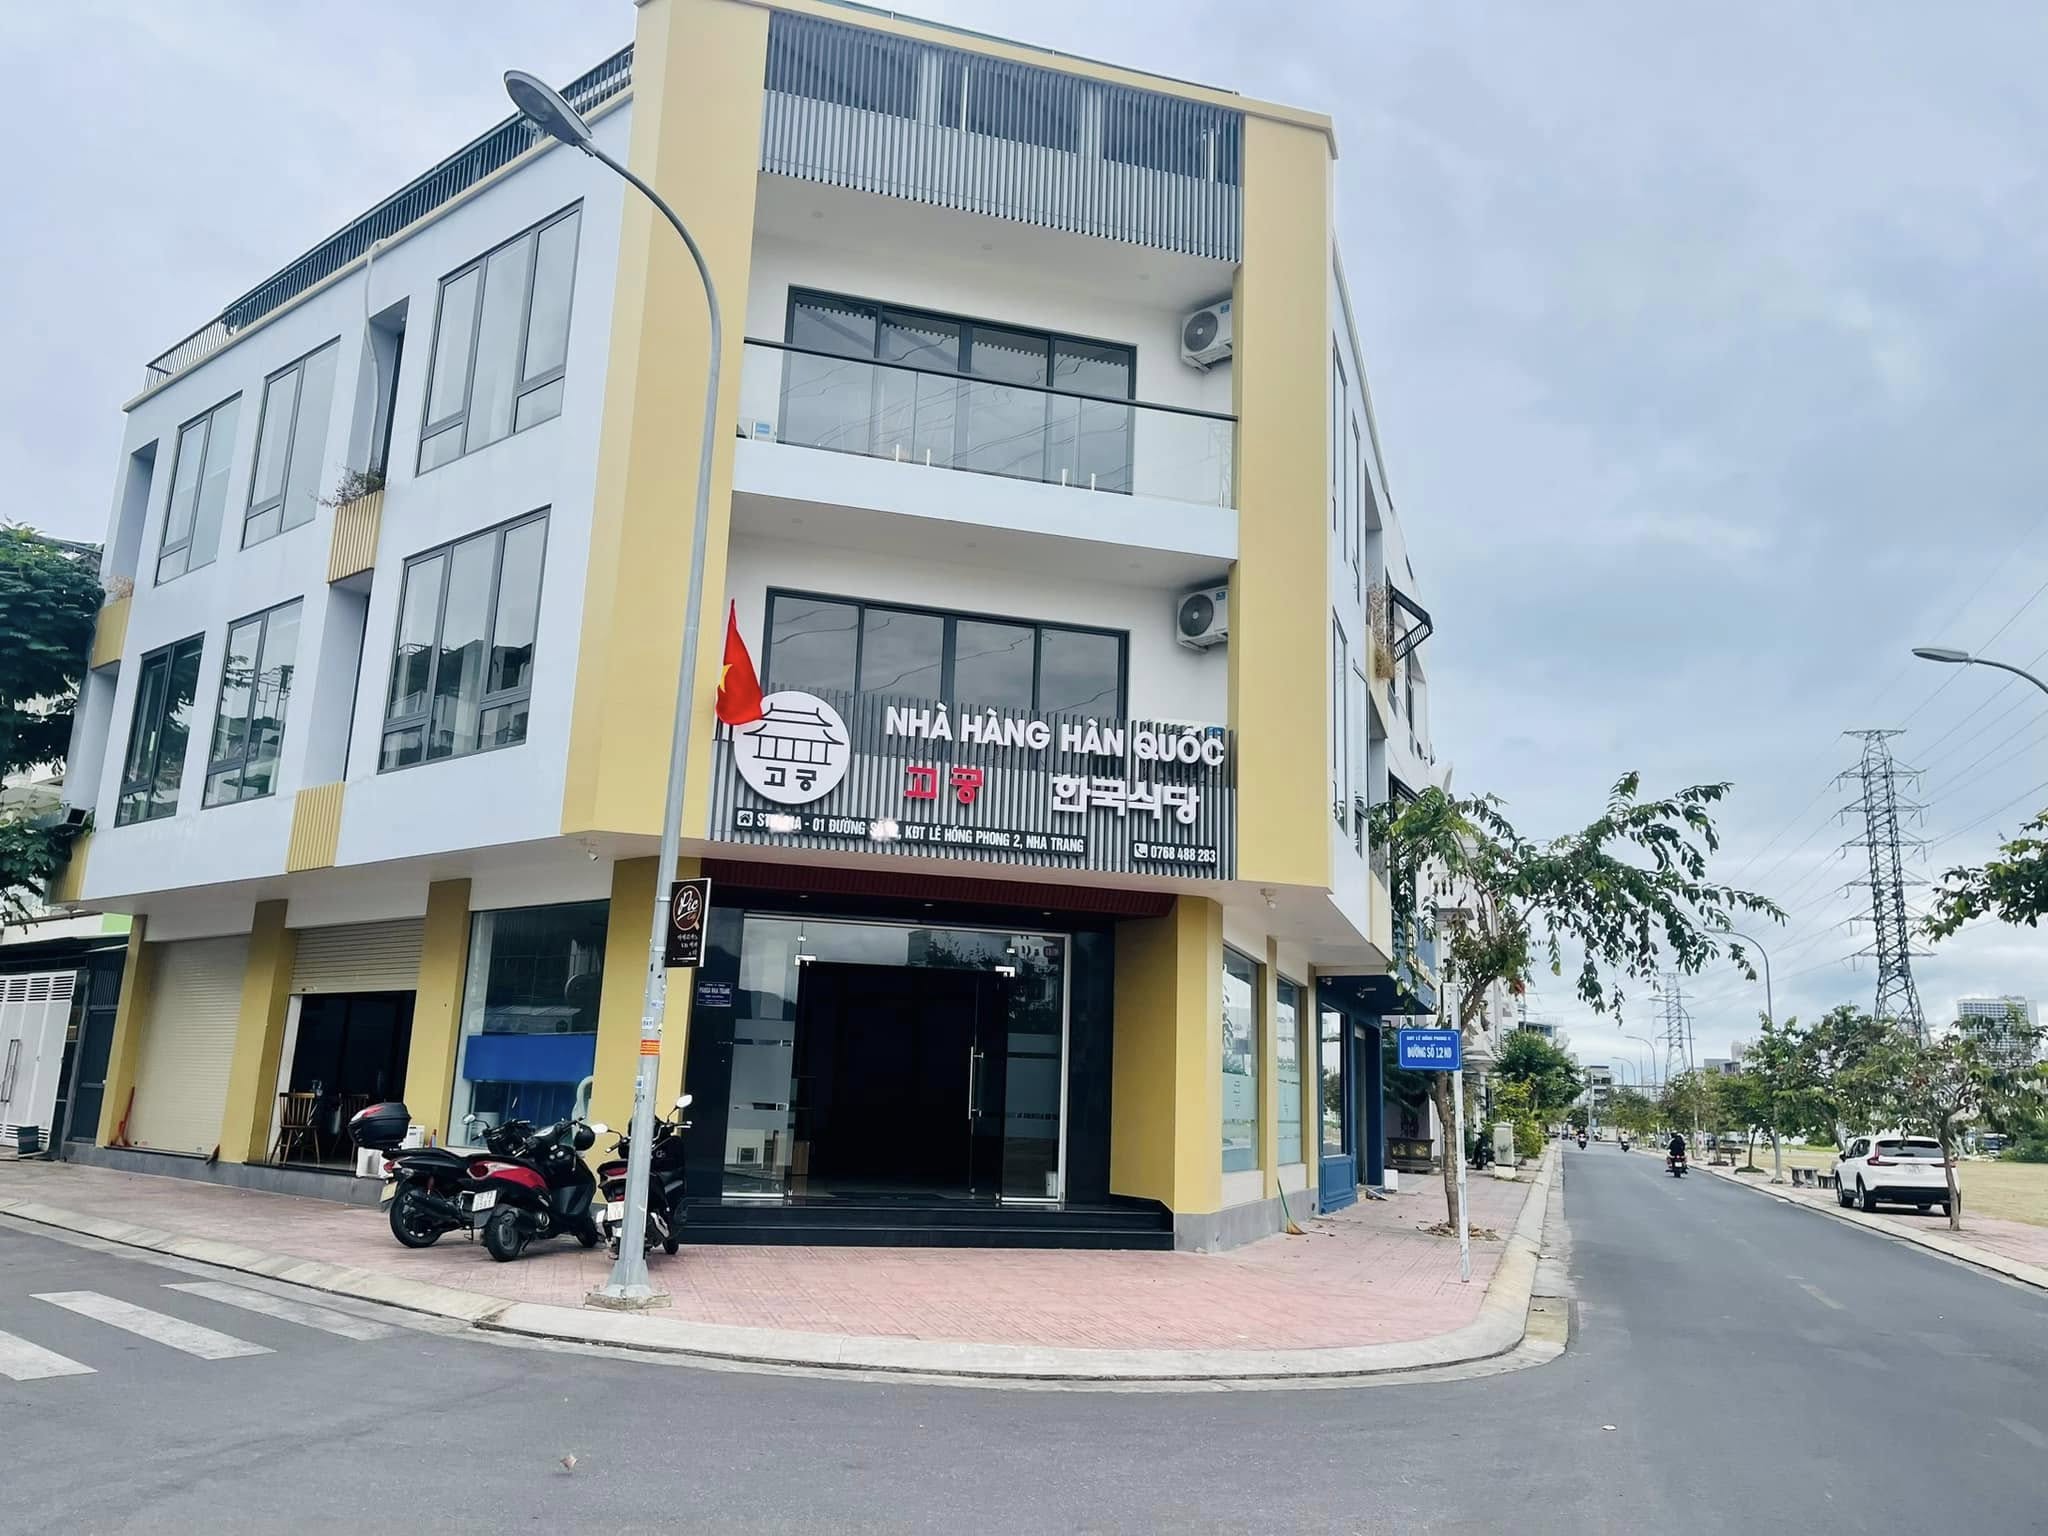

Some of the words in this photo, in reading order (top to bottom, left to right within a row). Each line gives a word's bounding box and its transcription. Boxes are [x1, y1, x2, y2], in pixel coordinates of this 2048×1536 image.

[886, 702, 953, 741] NHÀ
[960, 708, 1051, 750] HÀNG
[1061, 718, 1124, 757] HÀN
[1133, 728, 1225, 766] QUỐC
[1052, 774, 1200, 825] 한국식당
[812, 817, 825, 832] 01
[828, 817, 866, 836] ĐƯỜNG
[905, 825, 925, 840] KĐT
[929, 825, 941, 841] LÊ
[975, 830, 1010, 847] PHONG
[1013, 834, 1023, 849] 2,
[1026, 835, 1047, 850] NHA
[1050, 837, 1084, 853] TRANG
[1150, 845, 1175, 860] 0768
[1177, 847, 1196, 861] 488
[1197, 849, 1216, 863] 283
[677, 890, 698, 915] Pic
